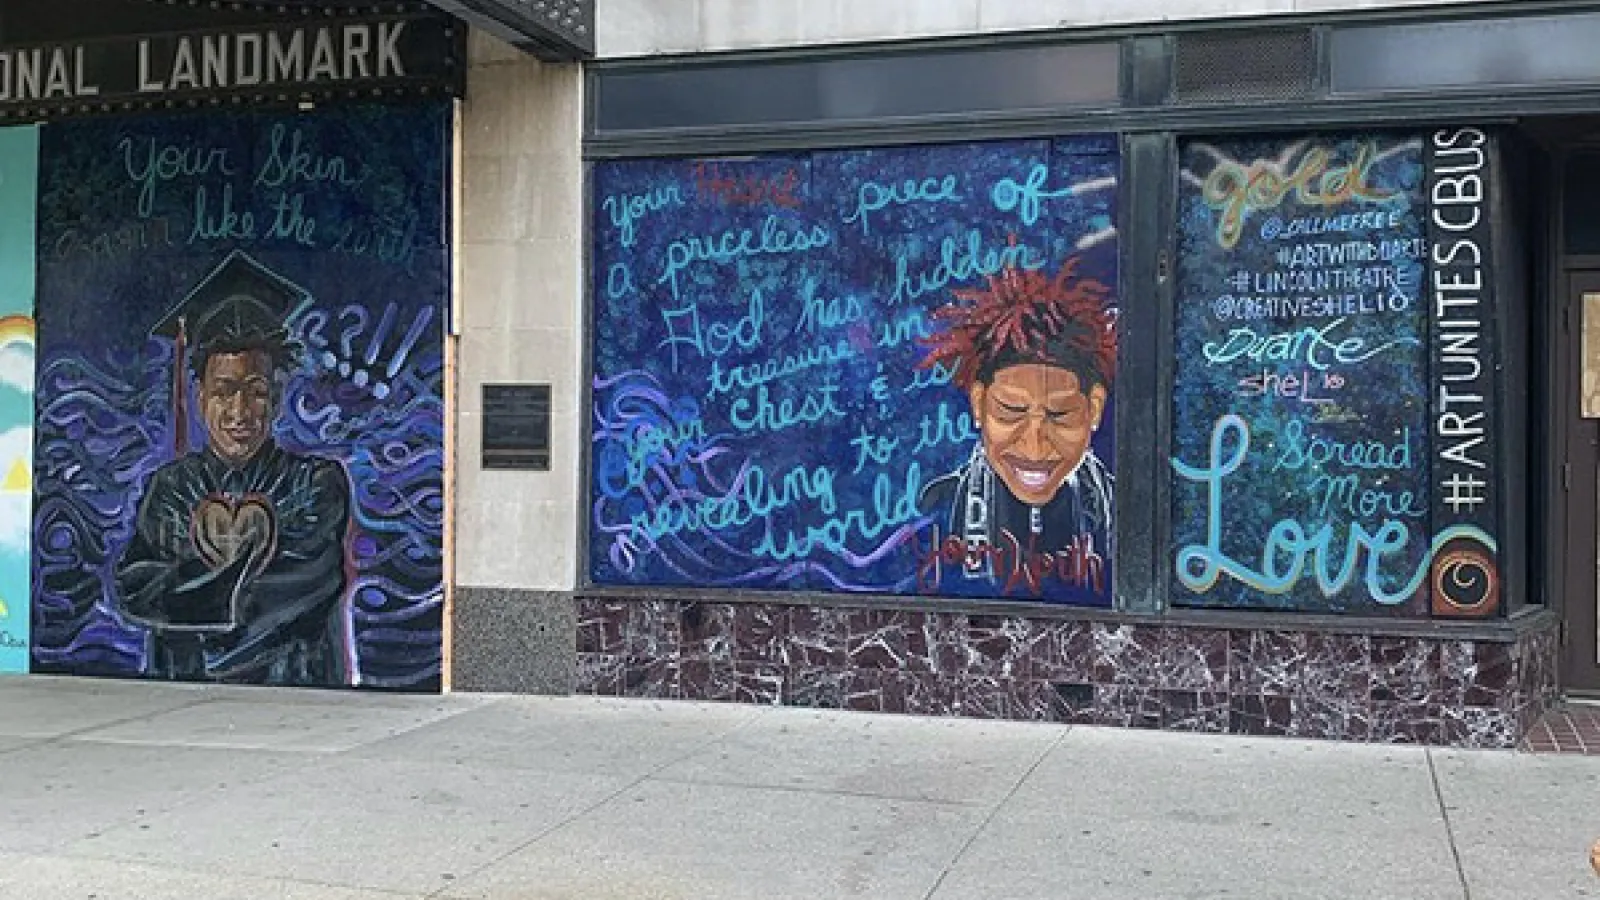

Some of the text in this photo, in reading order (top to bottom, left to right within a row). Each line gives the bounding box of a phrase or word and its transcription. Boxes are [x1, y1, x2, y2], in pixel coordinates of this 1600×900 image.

[138, 21, 405, 93] LANDMARK
[187, 182, 257, 245] like
[264, 192, 316, 247] the
[658, 214, 829, 300] priceless
[841, 174, 964, 236] piece
[992, 163, 1074, 226] of
[795, 278, 862, 333] has
[888, 230, 1048, 305] hidden
[877, 312, 932, 347] in
[848, 426, 899, 474] to
[912, 402, 978, 454] the
[1272, 420, 1412, 473] Spread
[751, 463, 923, 560] world
[1169, 414, 1433, 604] Love
